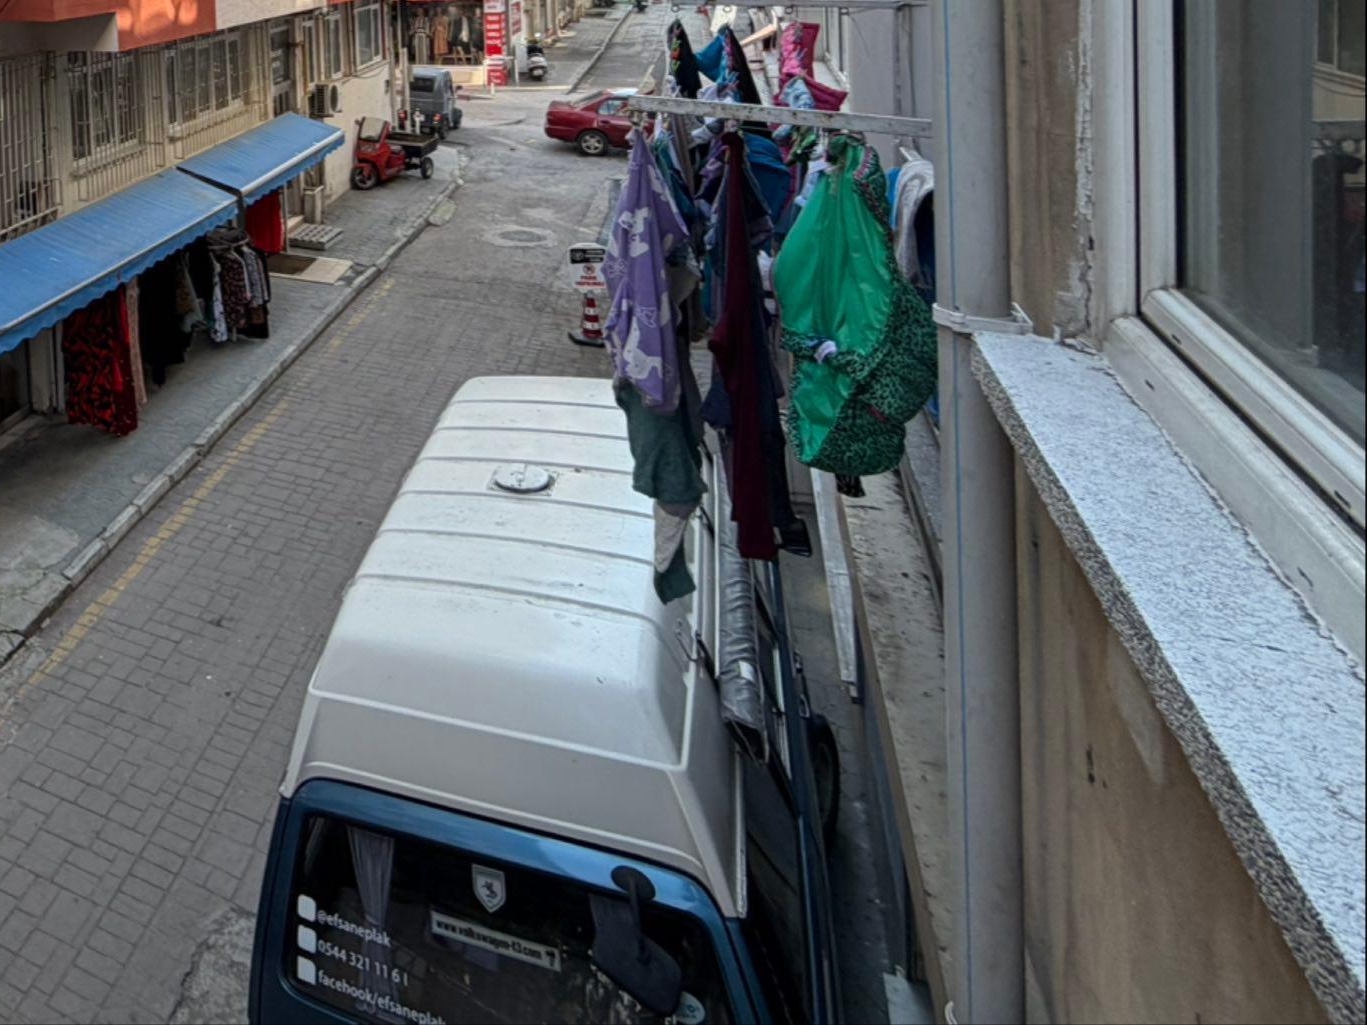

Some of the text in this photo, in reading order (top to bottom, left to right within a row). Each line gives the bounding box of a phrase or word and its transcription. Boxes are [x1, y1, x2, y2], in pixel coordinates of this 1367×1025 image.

[317, 909, 392, 948] @efsaneplak
[317, 939, 347, 962] 0544
[349, 951, 370, 972] 321
[374, 961, 388, 979] 11
